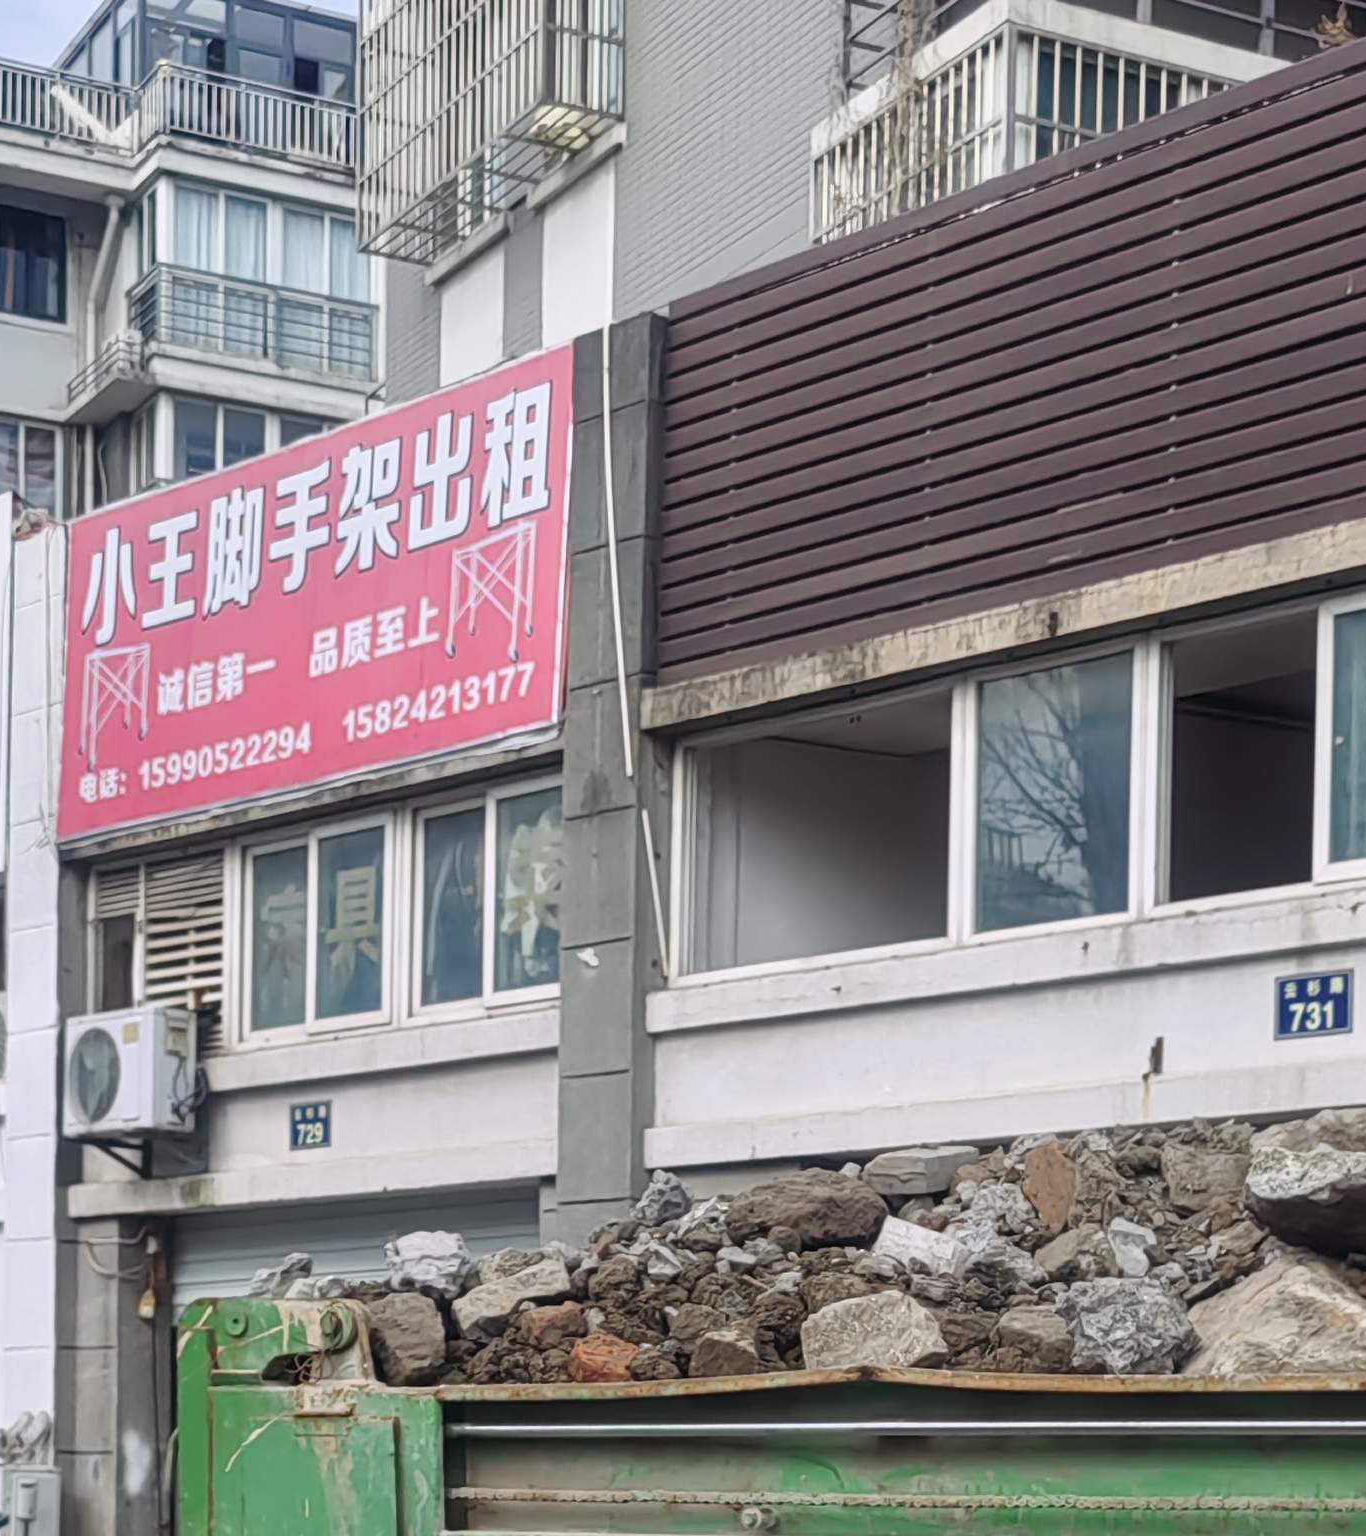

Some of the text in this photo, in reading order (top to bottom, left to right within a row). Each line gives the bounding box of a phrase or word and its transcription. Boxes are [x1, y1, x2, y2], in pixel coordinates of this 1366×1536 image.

[82, 382, 552, 645] 小王脚手架出租
[158, 597, 440, 715] 诚信第一 品质至上
[138, 723, 311, 791] 15990522294
[342, 663, 536, 742] 15824213177
[1289, 1000, 1334, 1032] 731
[297, 1121, 323, 1144] 729
